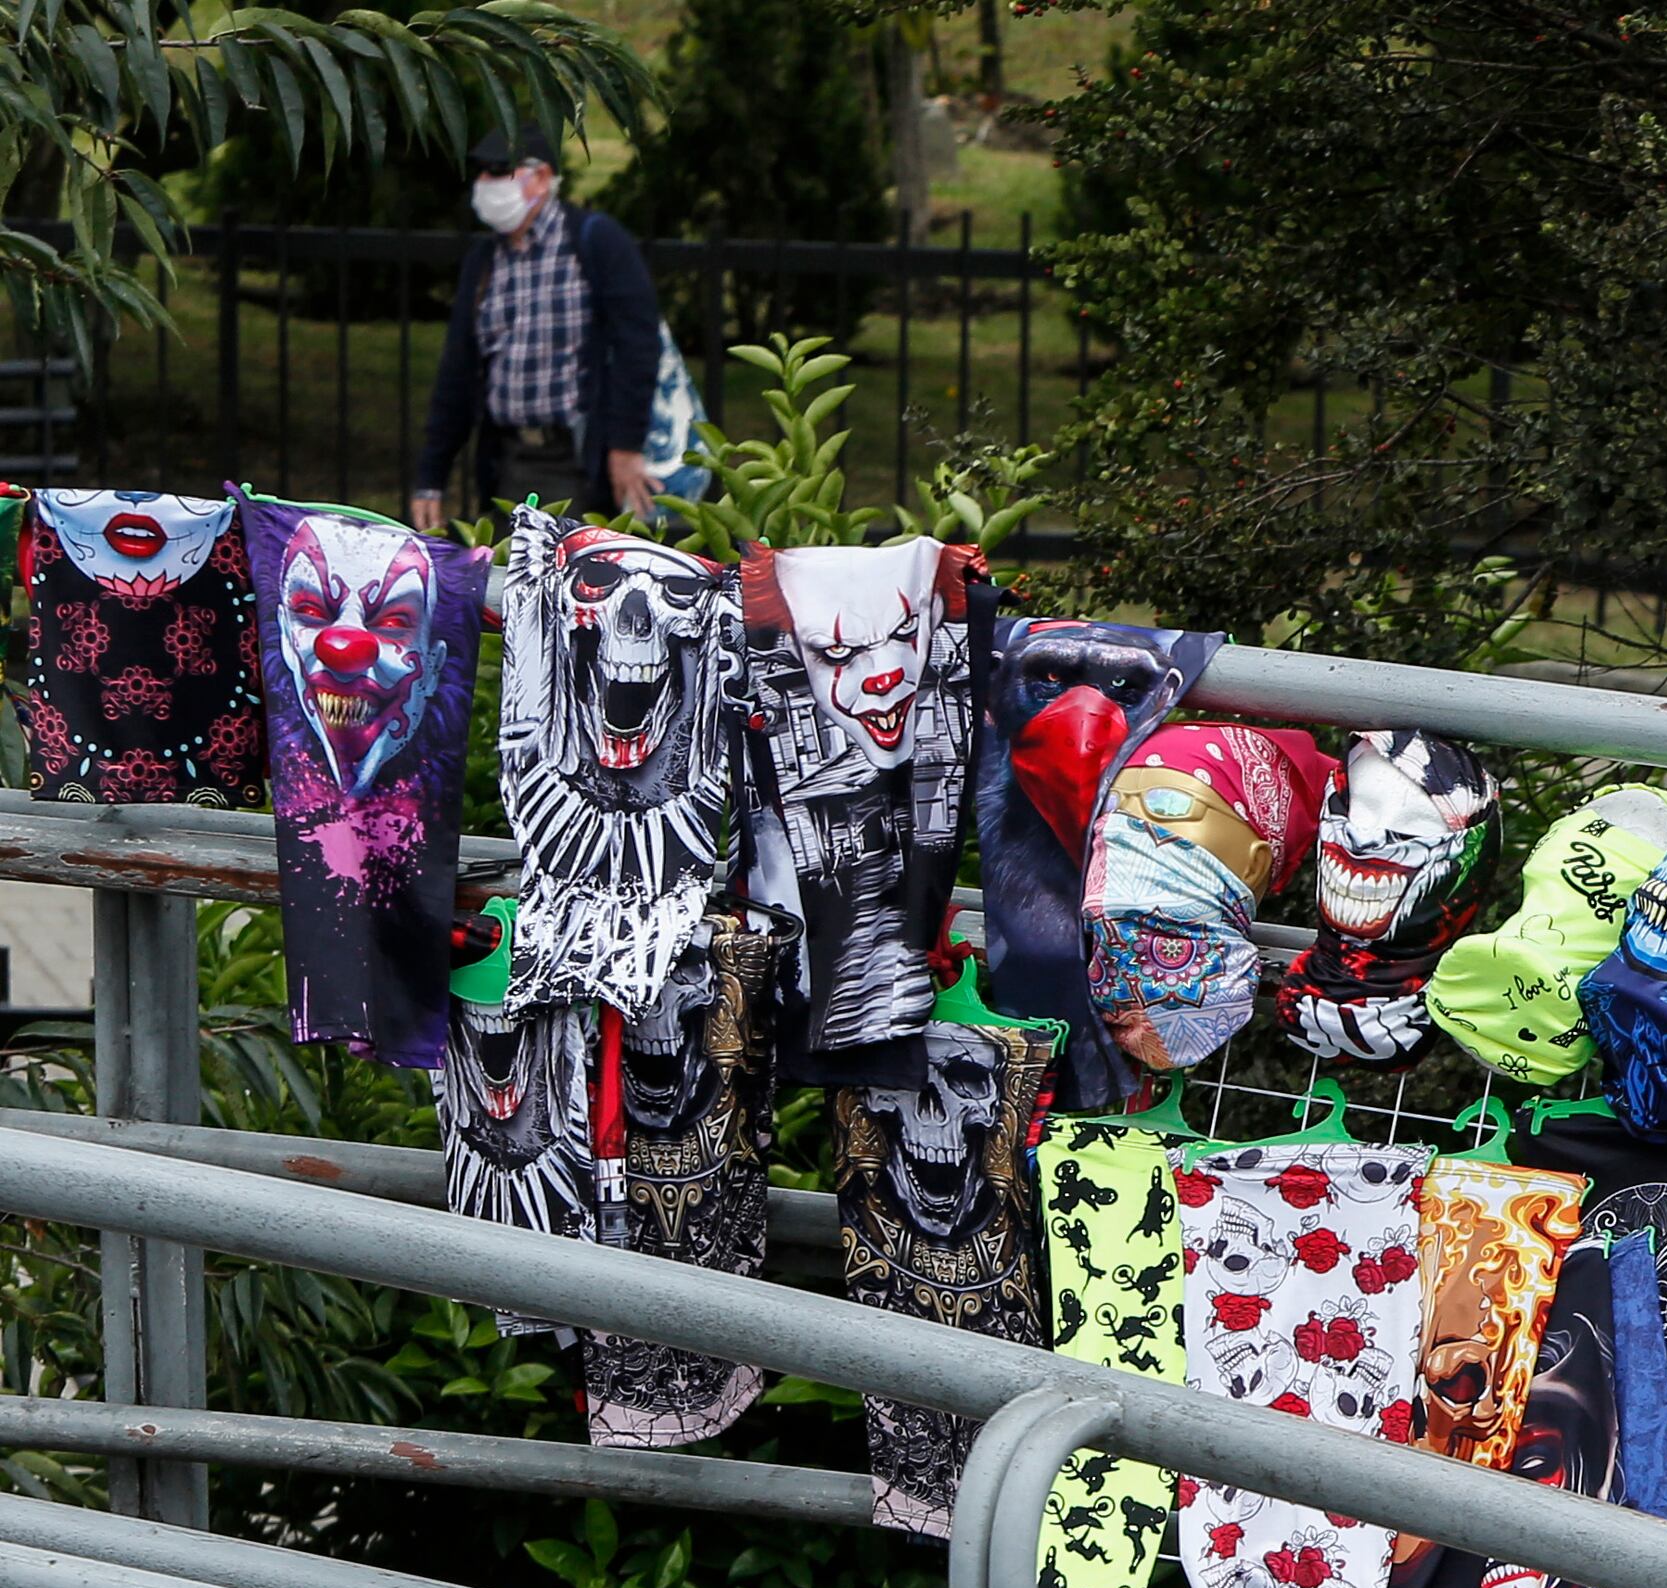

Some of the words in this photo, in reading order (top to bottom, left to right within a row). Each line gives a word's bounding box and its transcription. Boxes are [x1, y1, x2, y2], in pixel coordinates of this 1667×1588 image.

[1561, 841, 1628, 924] Paris
[1502, 987, 1518, 1011] I
[1513, 974, 1552, 1002] love
